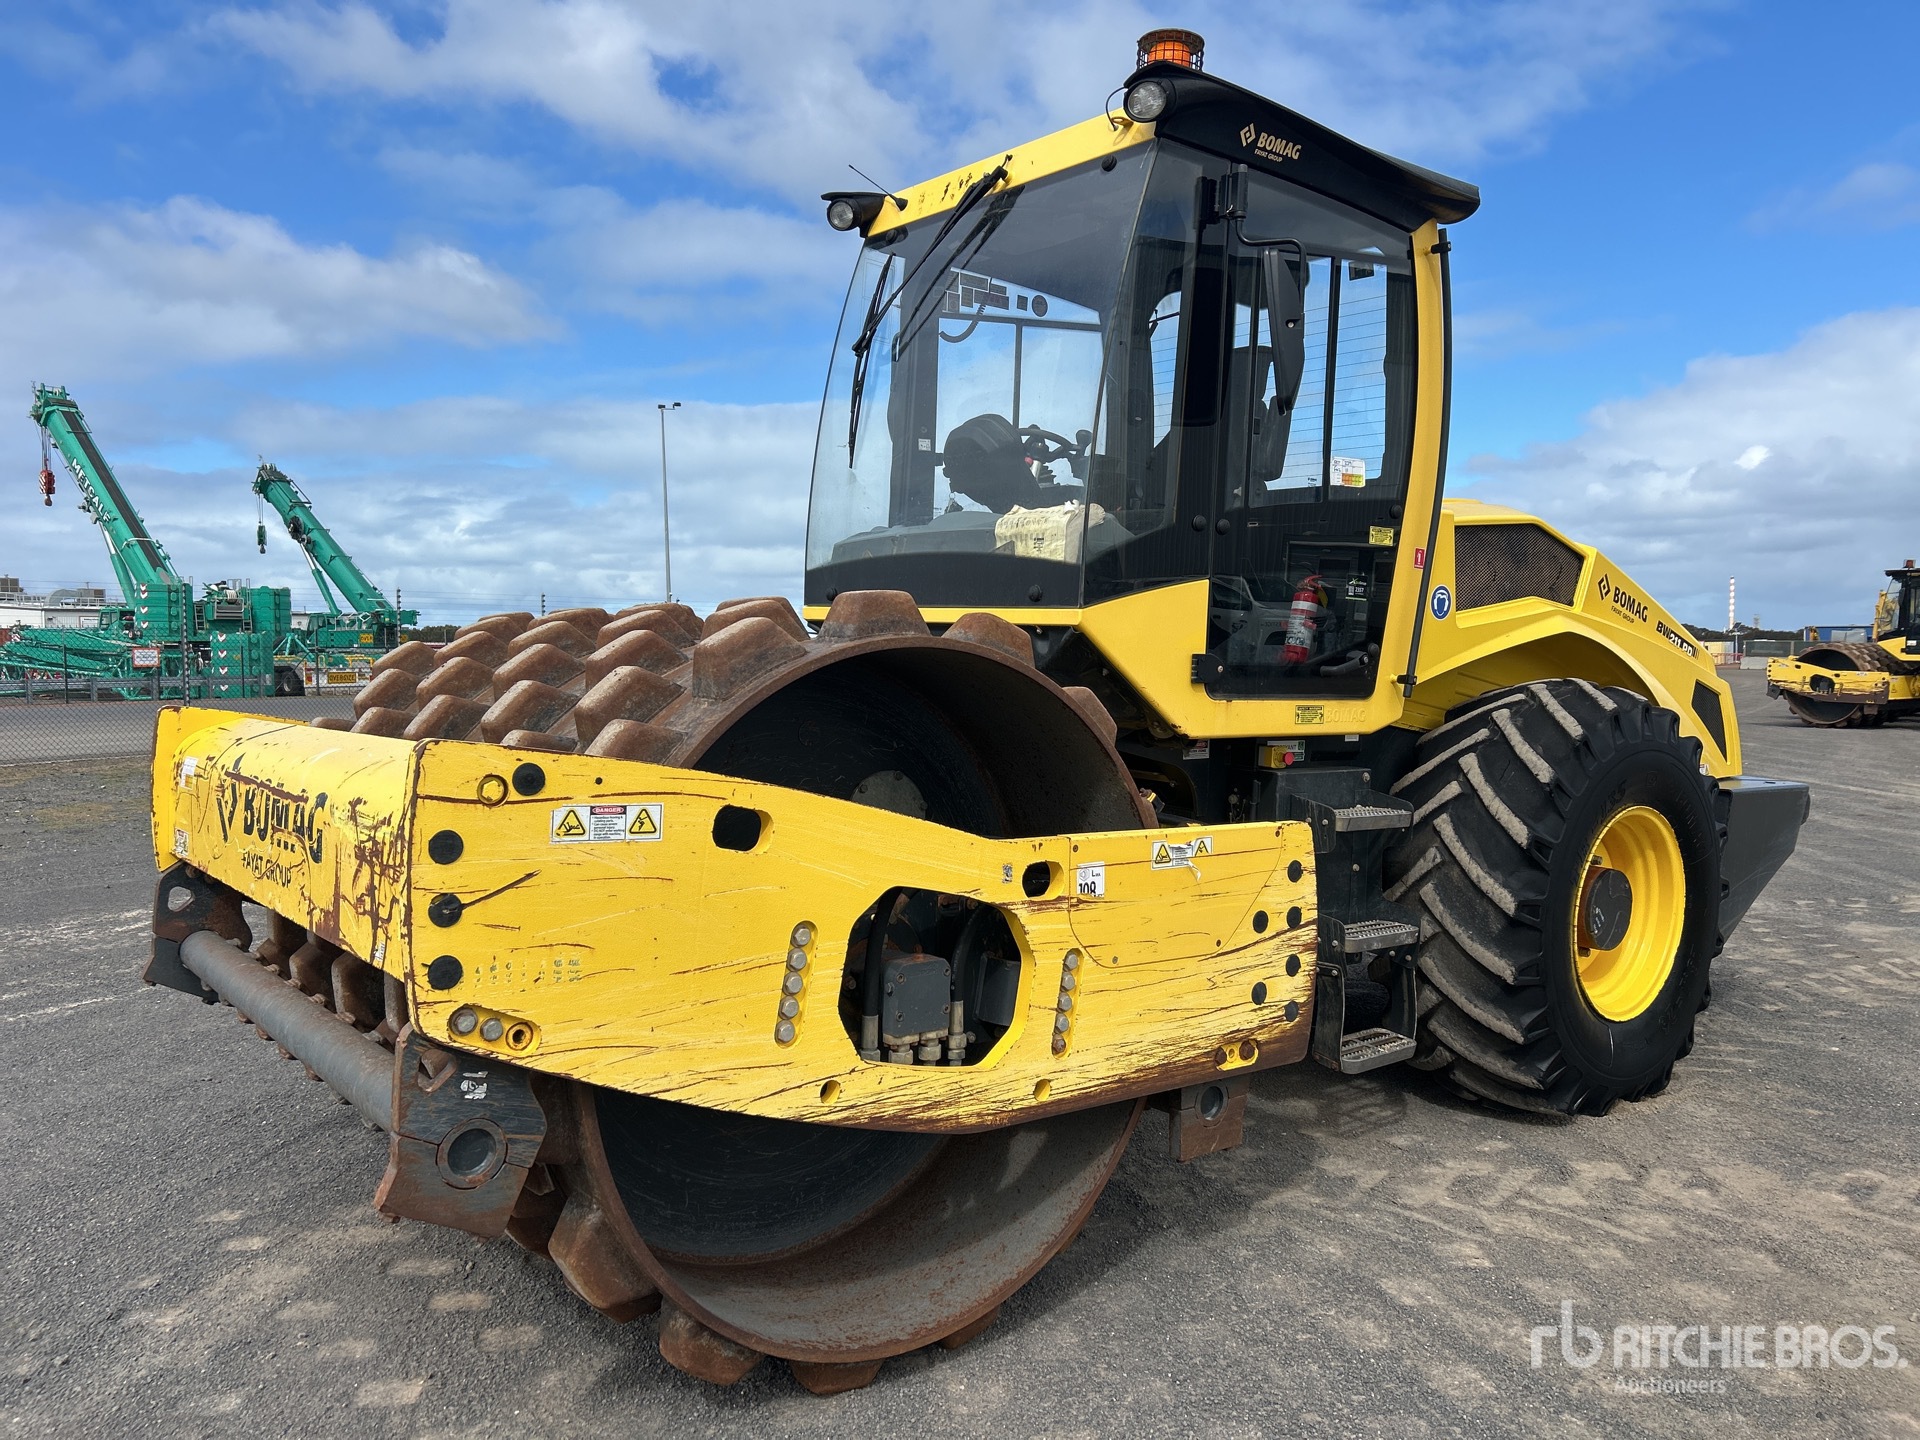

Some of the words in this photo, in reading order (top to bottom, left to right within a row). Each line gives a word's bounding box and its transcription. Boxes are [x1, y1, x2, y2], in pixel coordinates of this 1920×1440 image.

[1257, 132, 1302, 160] BOMAG
[1267, 153, 1283, 163] GROUP
[71, 458, 111, 522] METCALF
[1613, 586, 1648, 622] BOMAG
[328, 672, 356, 682] OVERSIZE
[1325, 708, 1366, 723] BOMAG
